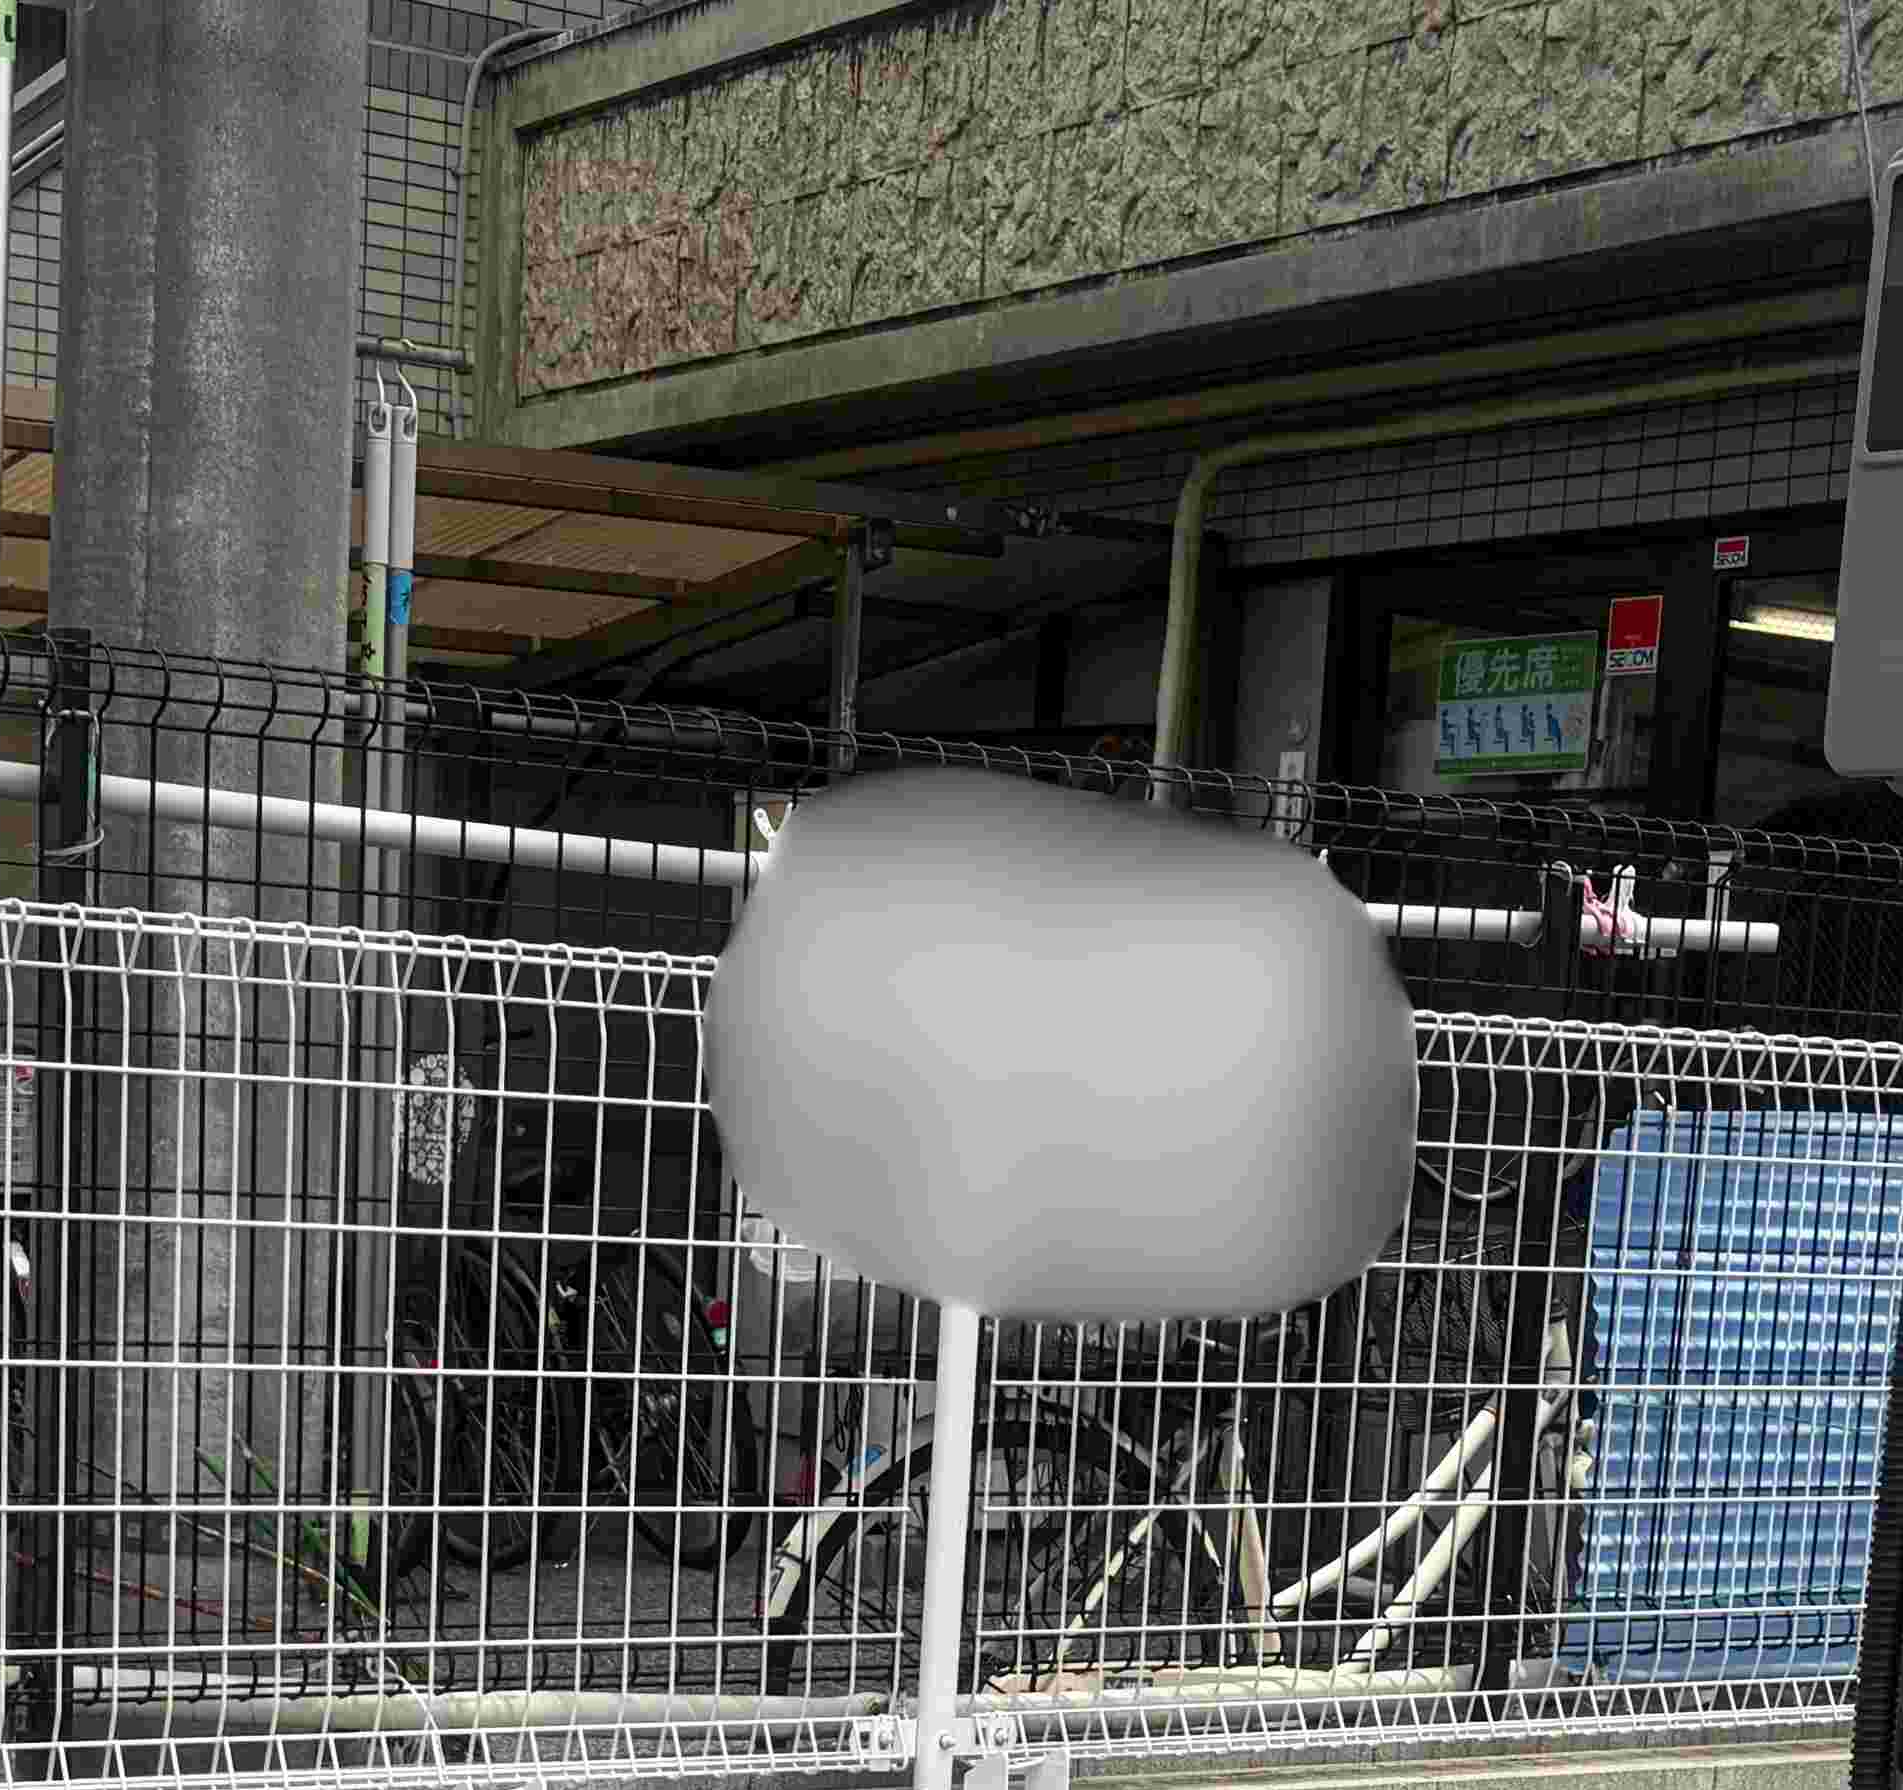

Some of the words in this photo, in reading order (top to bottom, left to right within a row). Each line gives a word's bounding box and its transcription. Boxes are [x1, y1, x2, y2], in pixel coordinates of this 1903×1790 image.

[1456, 645, 1559, 696] 優先席
[1608, 650, 1655, 667] SECOM
